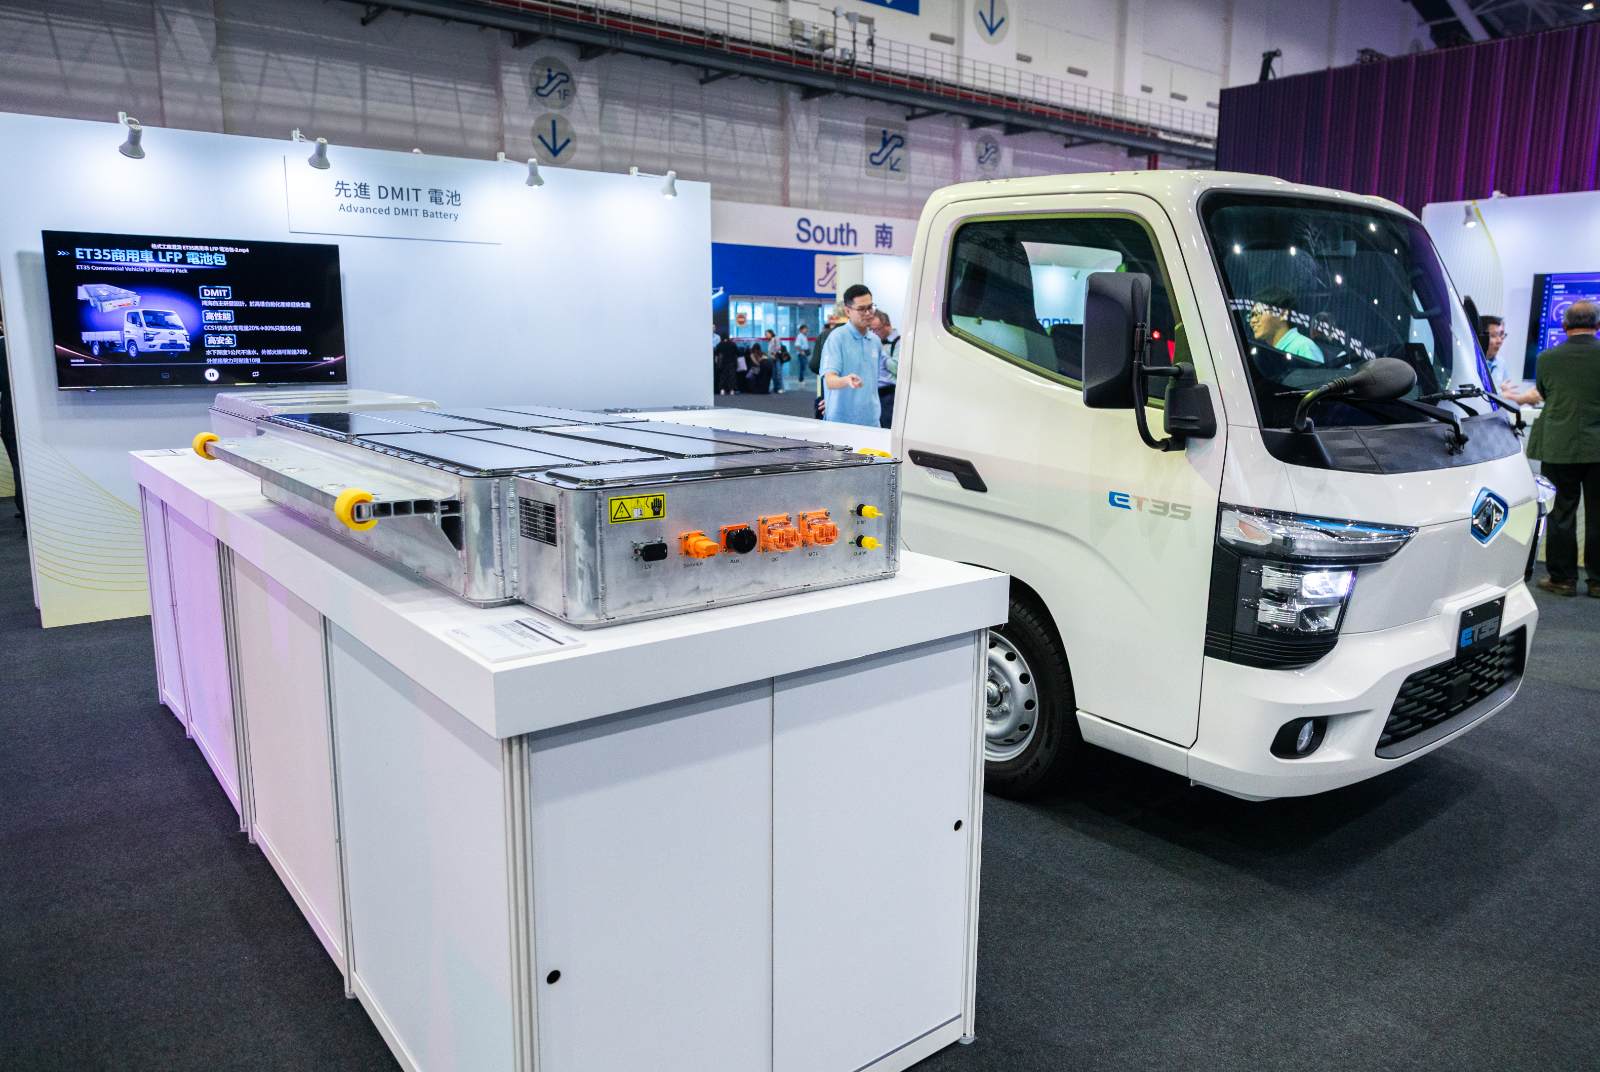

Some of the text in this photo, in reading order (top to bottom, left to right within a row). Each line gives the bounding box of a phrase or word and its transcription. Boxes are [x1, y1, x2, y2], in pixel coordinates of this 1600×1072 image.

[557, 89, 571, 101] 1F
[334, 180, 462, 206] 先進 DMIT 電池
[338, 203, 459, 221] Advanced DMIT Battery
[796, 217, 893, 249] South 南
[75, 247, 228, 266] ET35商用車 LFP 電池包
[203, 288, 228, 297] DMIT
[205, 311, 232, 321] 高性能
[207, 335, 234, 345] 高安全
[1108, 490, 1192, 521] ET35
